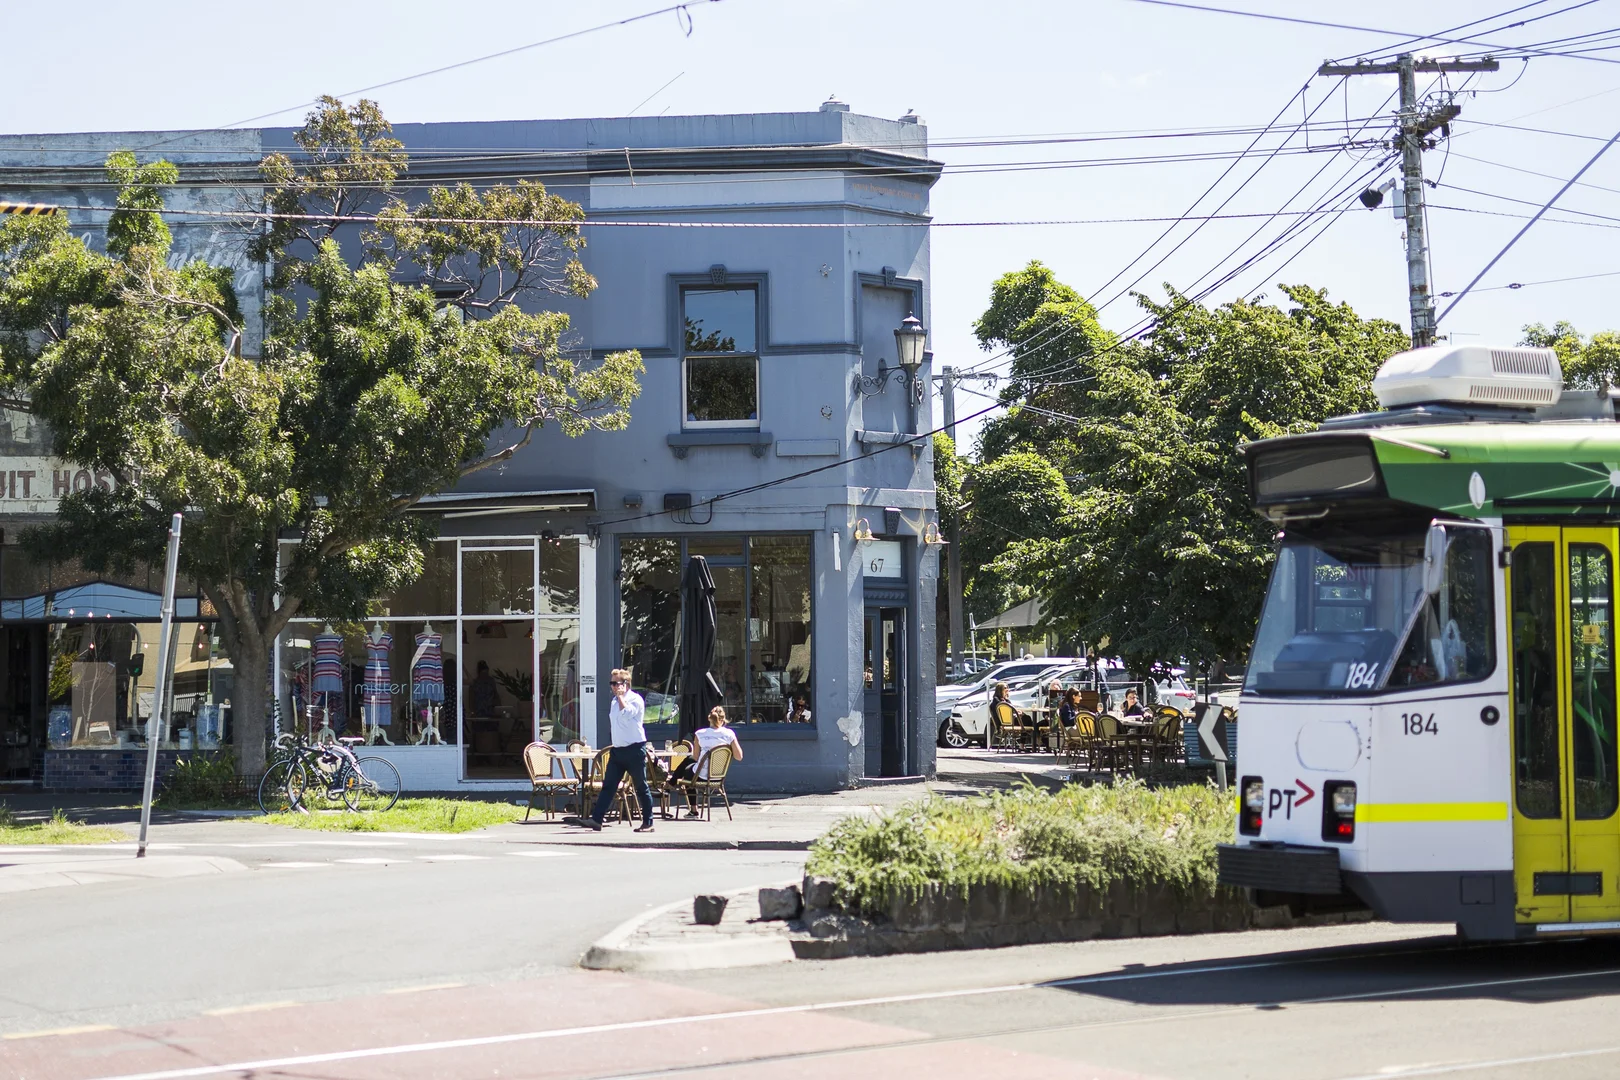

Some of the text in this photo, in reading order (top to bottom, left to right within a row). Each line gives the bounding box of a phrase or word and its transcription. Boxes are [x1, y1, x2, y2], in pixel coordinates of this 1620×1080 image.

[870, 558, 885, 573] 67
[1344, 662, 1379, 689] 184
[354, 681, 444, 695] mister zimi
[1401, 713, 1439, 736] 184
